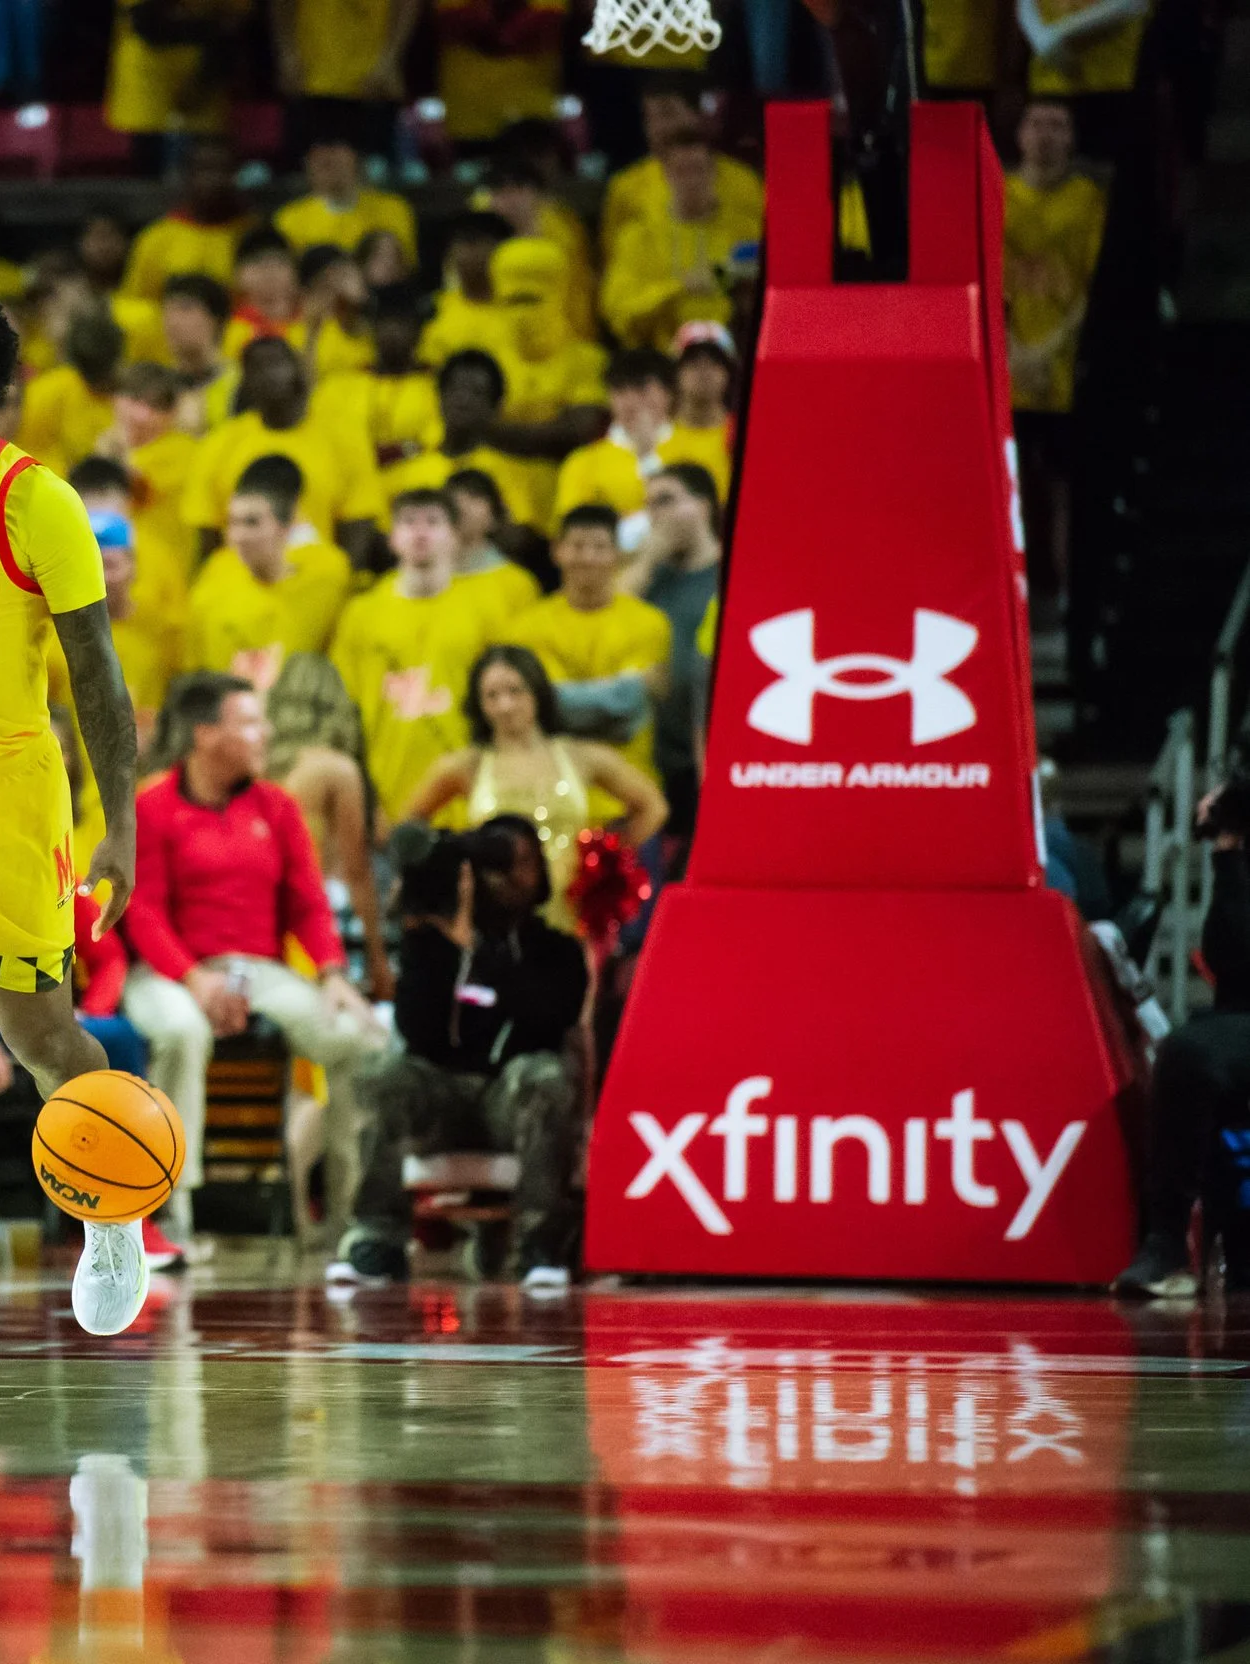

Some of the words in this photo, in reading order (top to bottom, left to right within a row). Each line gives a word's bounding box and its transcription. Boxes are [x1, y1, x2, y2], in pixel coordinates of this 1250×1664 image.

[729, 761, 845, 789] UNDER
[845, 761, 991, 789] ARMOUR
[624, 1075, 1088, 1242] xfinity
[40, 1162, 101, 1210] NCAA
